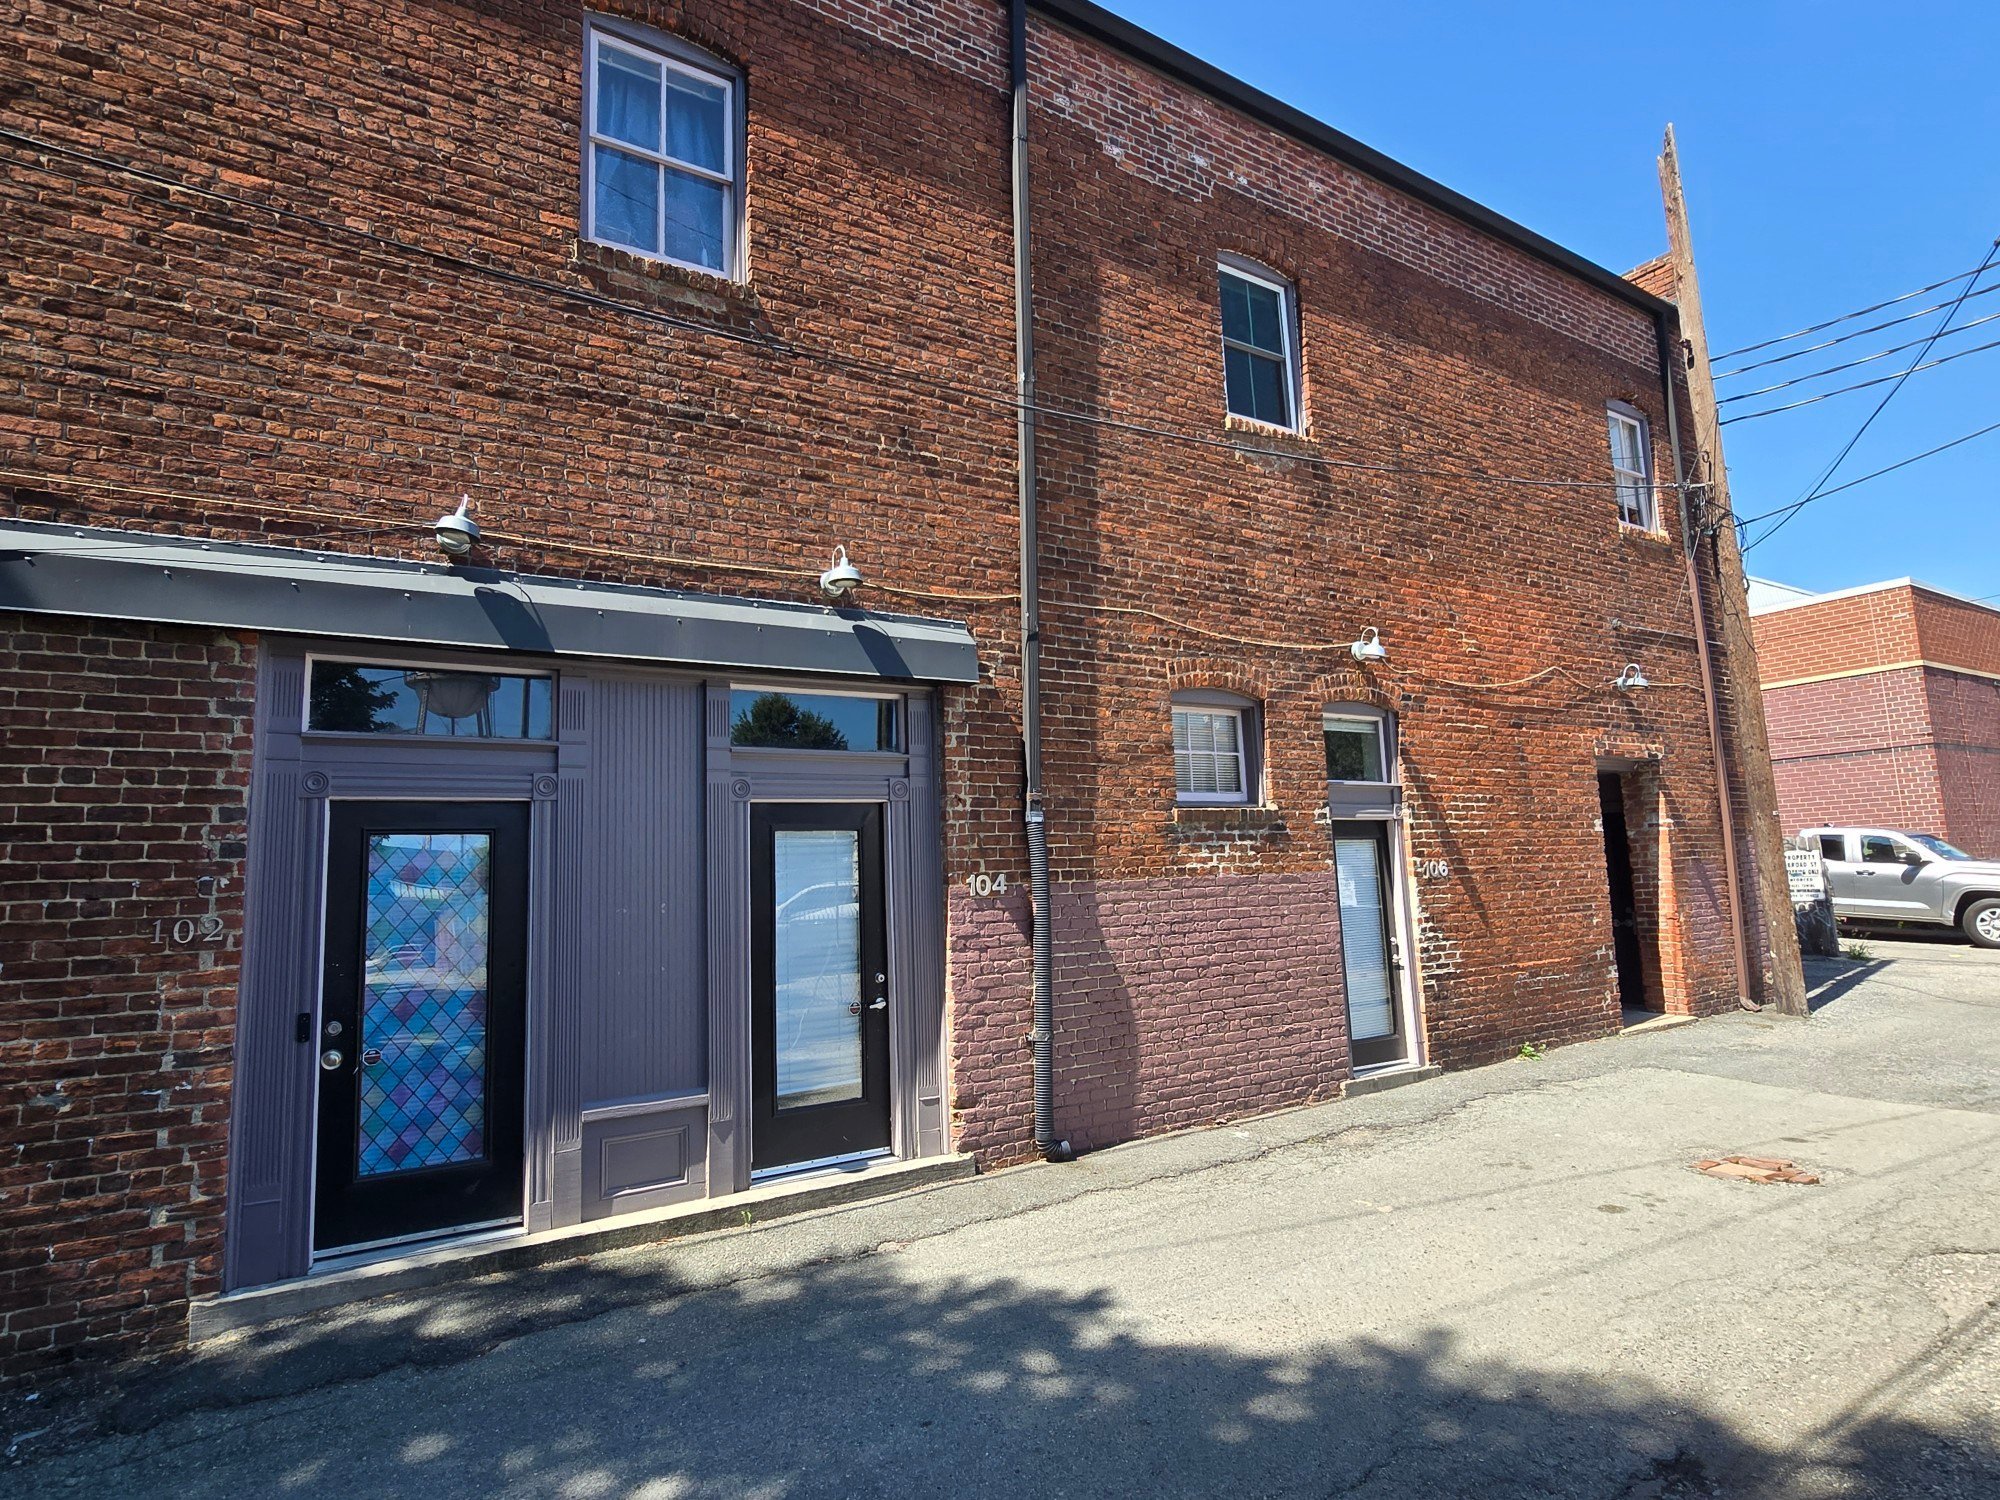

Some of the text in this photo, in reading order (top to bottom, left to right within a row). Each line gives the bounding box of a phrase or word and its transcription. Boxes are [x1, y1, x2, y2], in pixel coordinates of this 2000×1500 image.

[1423, 860, 1449, 878] 106
[966, 873, 1008, 897] 104
[150, 917, 224, 944] 102
